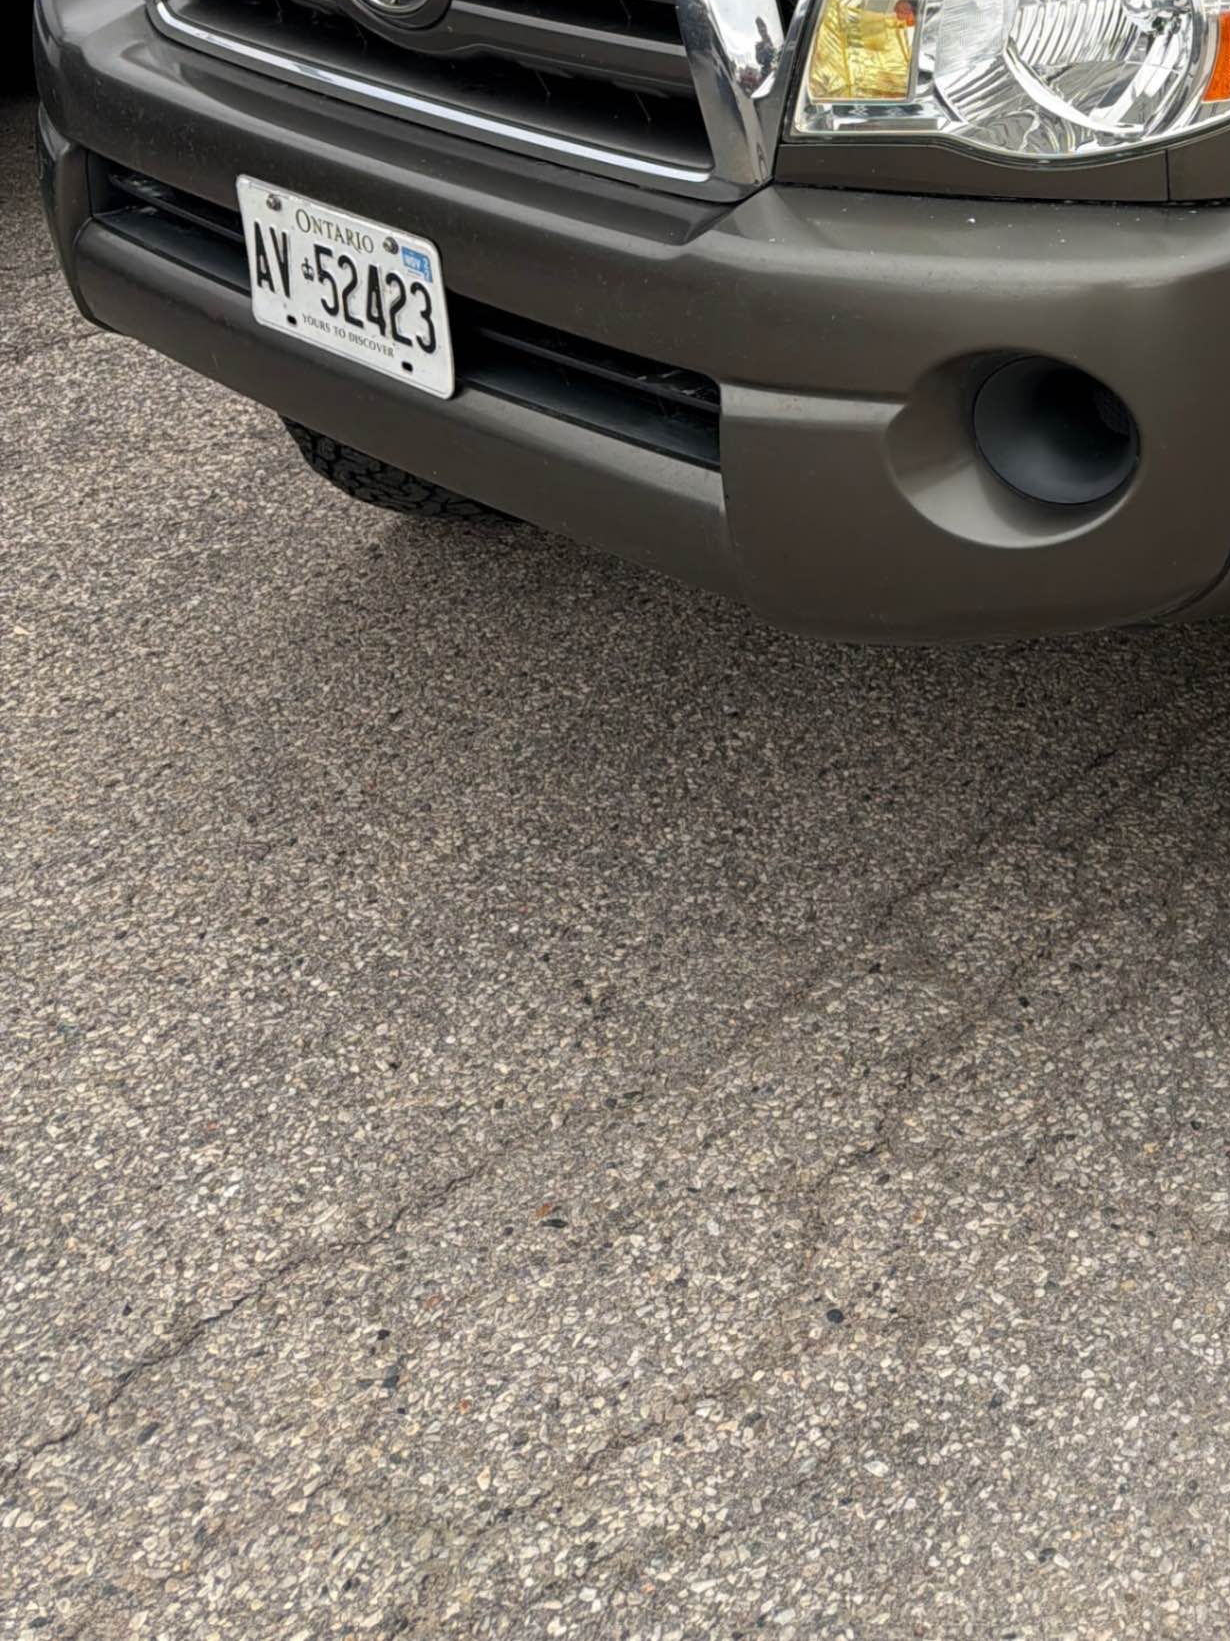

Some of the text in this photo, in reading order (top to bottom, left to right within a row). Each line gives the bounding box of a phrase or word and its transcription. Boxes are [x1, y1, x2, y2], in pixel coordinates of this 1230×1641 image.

[295, 208, 375, 254] ONTARIO
[253, 220, 437, 354] AV 52423
[301, 312, 394, 358] YOURS TO DISCOVER
